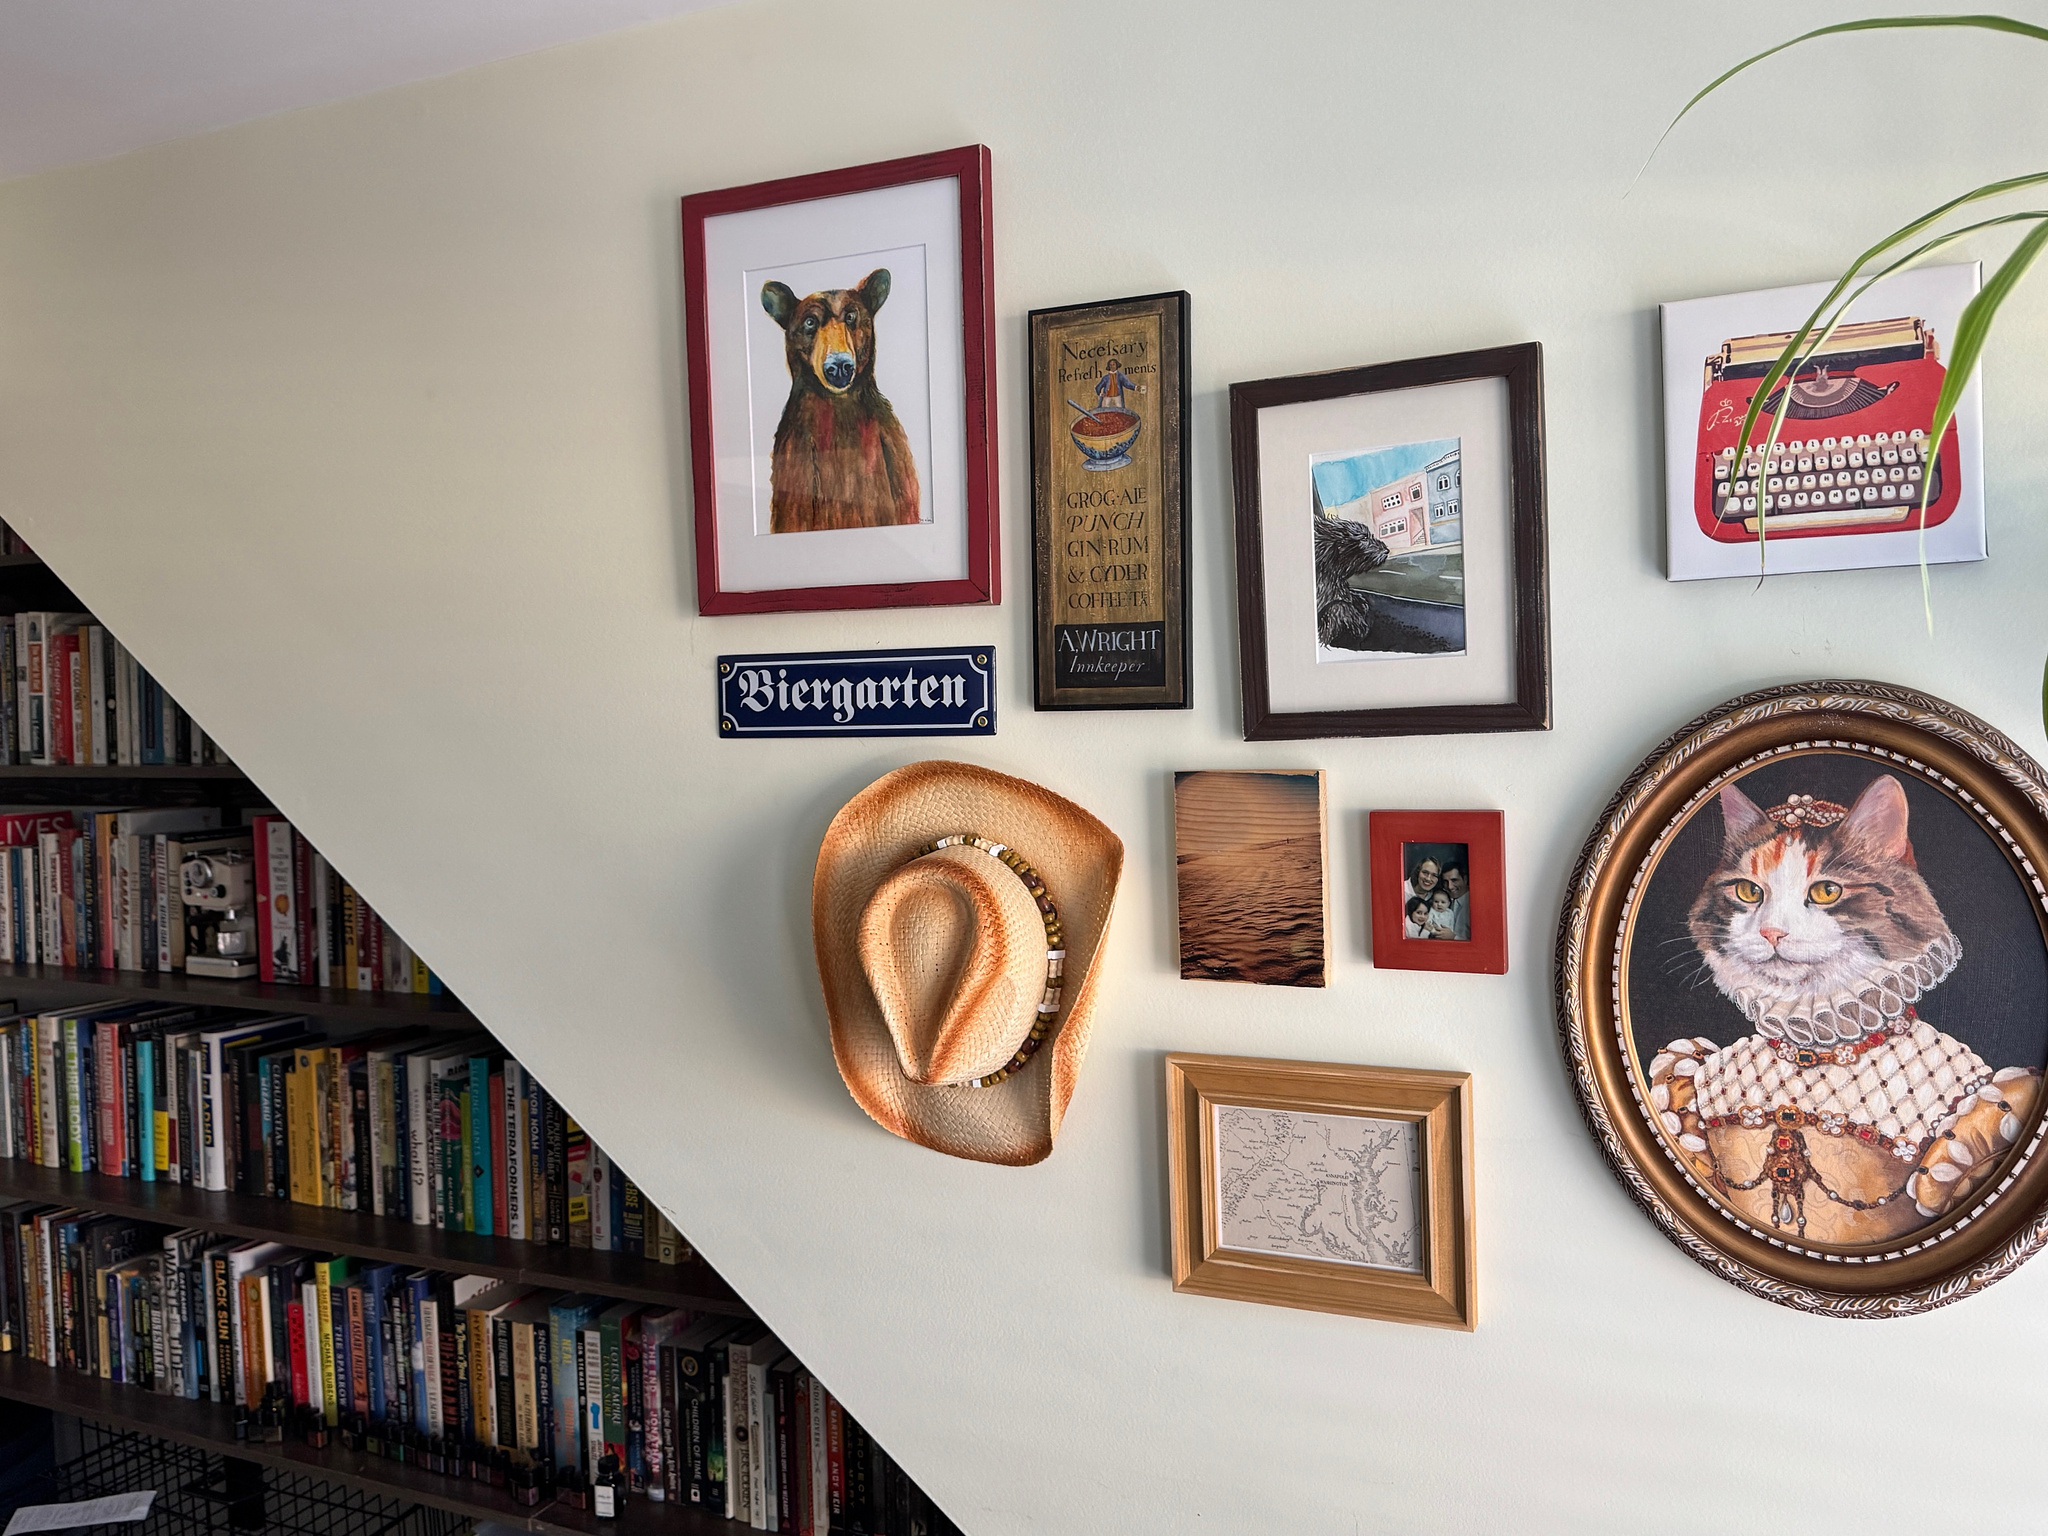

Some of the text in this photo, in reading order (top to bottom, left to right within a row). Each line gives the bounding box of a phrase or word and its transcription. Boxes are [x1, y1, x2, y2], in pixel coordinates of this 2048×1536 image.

[1067, 511, 1145, 533] PUNCH
[1067, 563, 1148, 584] & CYDER
[738, 666, 968, 723] Biergarten
[1069, 654, 1146, 681] Innkeeper
[0, 816, 65, 846] IVES
[343, 894, 354, 946] KINGS
[66, 1028, 81, 1144] THE THREE-BODY
[272, 1065, 284, 1146] CLOUD ATLAS
[393, 1064, 404, 1094] how
[471, 1064, 482, 1156] SLEEPING GIANTS
[203, 1099, 213, 1146] ADHD
[507, 1086, 519, 1220] THE TERRAFORMERS
[531, 1118, 541, 1150] NOAH
[546, 1101, 556, 1182] WILLIAM ABBEY
[553, 1123, 561, 1164] PURSUIT
[410, 1130, 423, 1186] what if?
[532, 1154, 540, 1178] BORN
[59, 1228, 71, 1336] FIRST COSMIC VELOCITY
[214, 1259, 229, 1340] BLACK SUN
[151, 1309, 165, 1378] BONESHAKER
[318, 1270, 335, 1407] THE SHERIFF MICHAEL RUBENS
[334, 1324, 347, 1408] THE SPARROW
[352, 1319, 362, 1351] CASCADE
[472, 1313, 484, 1382] HYPERION
[538, 1329, 549, 1404] SNOW CRASH
[550, 1314, 560, 1385] STEPHENSON
[561, 1339, 572, 1365] NEAL
[439, 1331, 459, 1426] COFFEELAND
[498, 1321, 512, 1446] NEAL STEPHENSON CRYPTONOMICON
[577, 1358, 586, 1391] STEWART
[610, 1346, 622, 1425] LOTUS EMPIRE
[648, 1344, 657, 1393] THE END
[732, 1352, 741, 1413] OF THE RING
[813, 1381, 821, 1414] INDIAN
[649, 1410, 660, 1473] JONATHAN
[691, 1398, 702, 1480] CHILDREN OF TIME
[830, 1409, 841, 1515] MARTIAN ANDY WEIR
[856, 1424, 866, 1505] PROJECT
[741, 1471, 750, 1508] TOLKIEN
